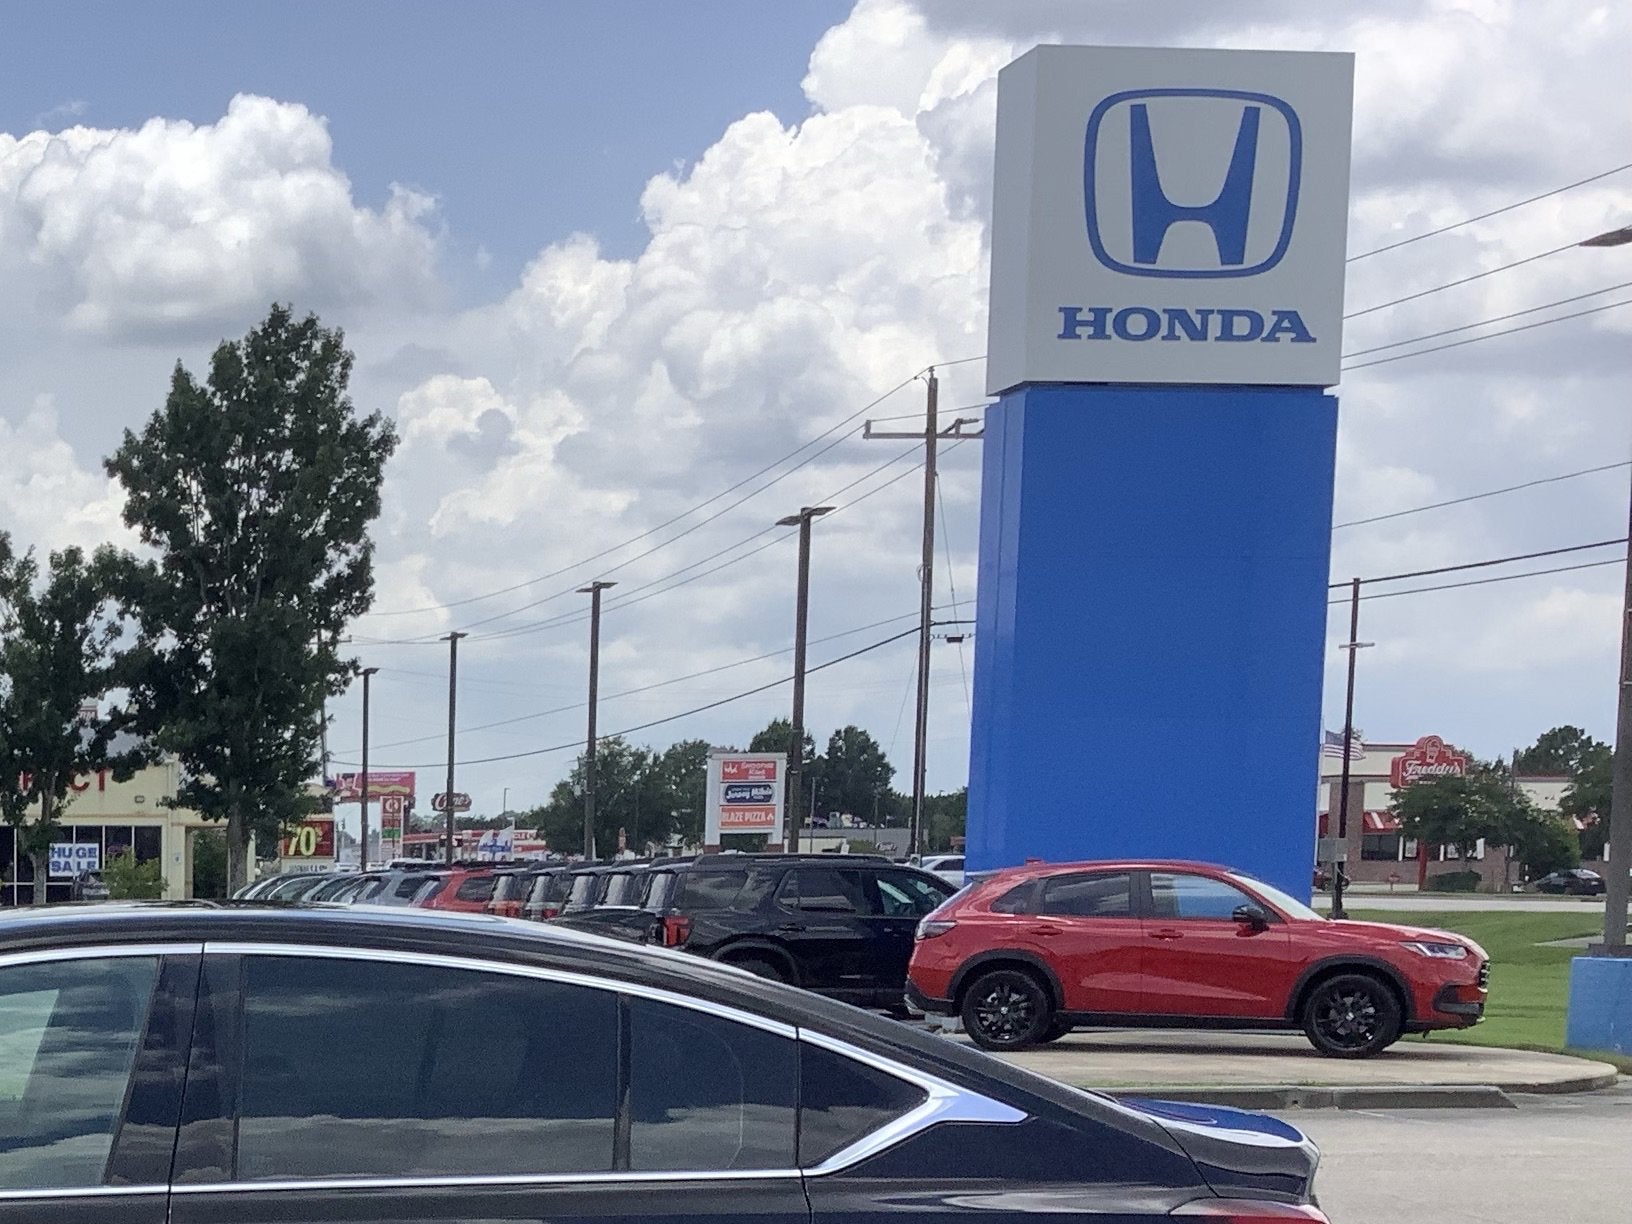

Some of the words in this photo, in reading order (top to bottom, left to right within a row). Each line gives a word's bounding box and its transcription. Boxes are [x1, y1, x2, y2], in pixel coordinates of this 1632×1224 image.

[1057, 306, 1317, 343] HONDA
[51, 847, 98, 859] HUGE
[51, 860, 99, 873] SALE
